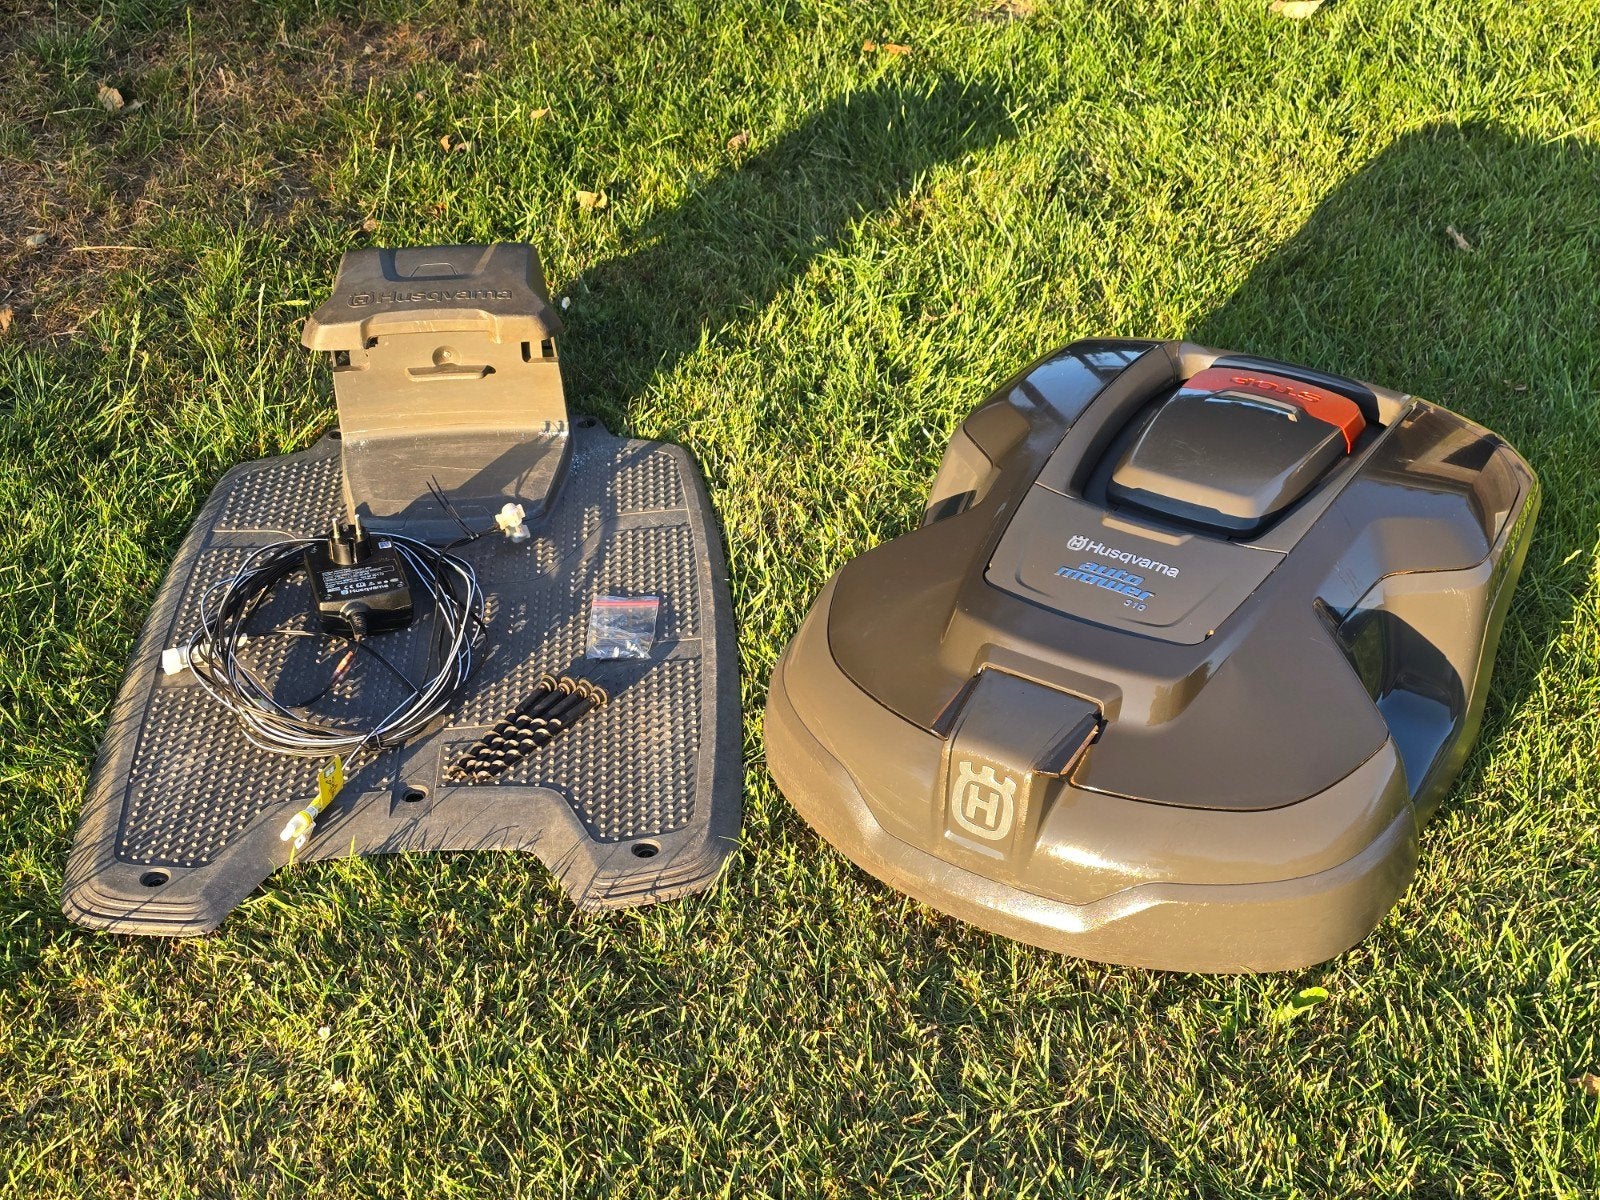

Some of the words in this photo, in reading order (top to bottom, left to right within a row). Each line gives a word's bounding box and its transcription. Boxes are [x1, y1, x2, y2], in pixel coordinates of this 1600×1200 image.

[376, 289, 513, 304] Husqvarna
[1231, 376, 1322, 403] STOP
[1086, 541, 1180, 578] Husqvarna
[1054, 566, 1156, 601] mower
[1079, 561, 1145, 587] auto
[349, 584, 389, 594] Husqvarna
[1123, 599, 1147, 612] 310
